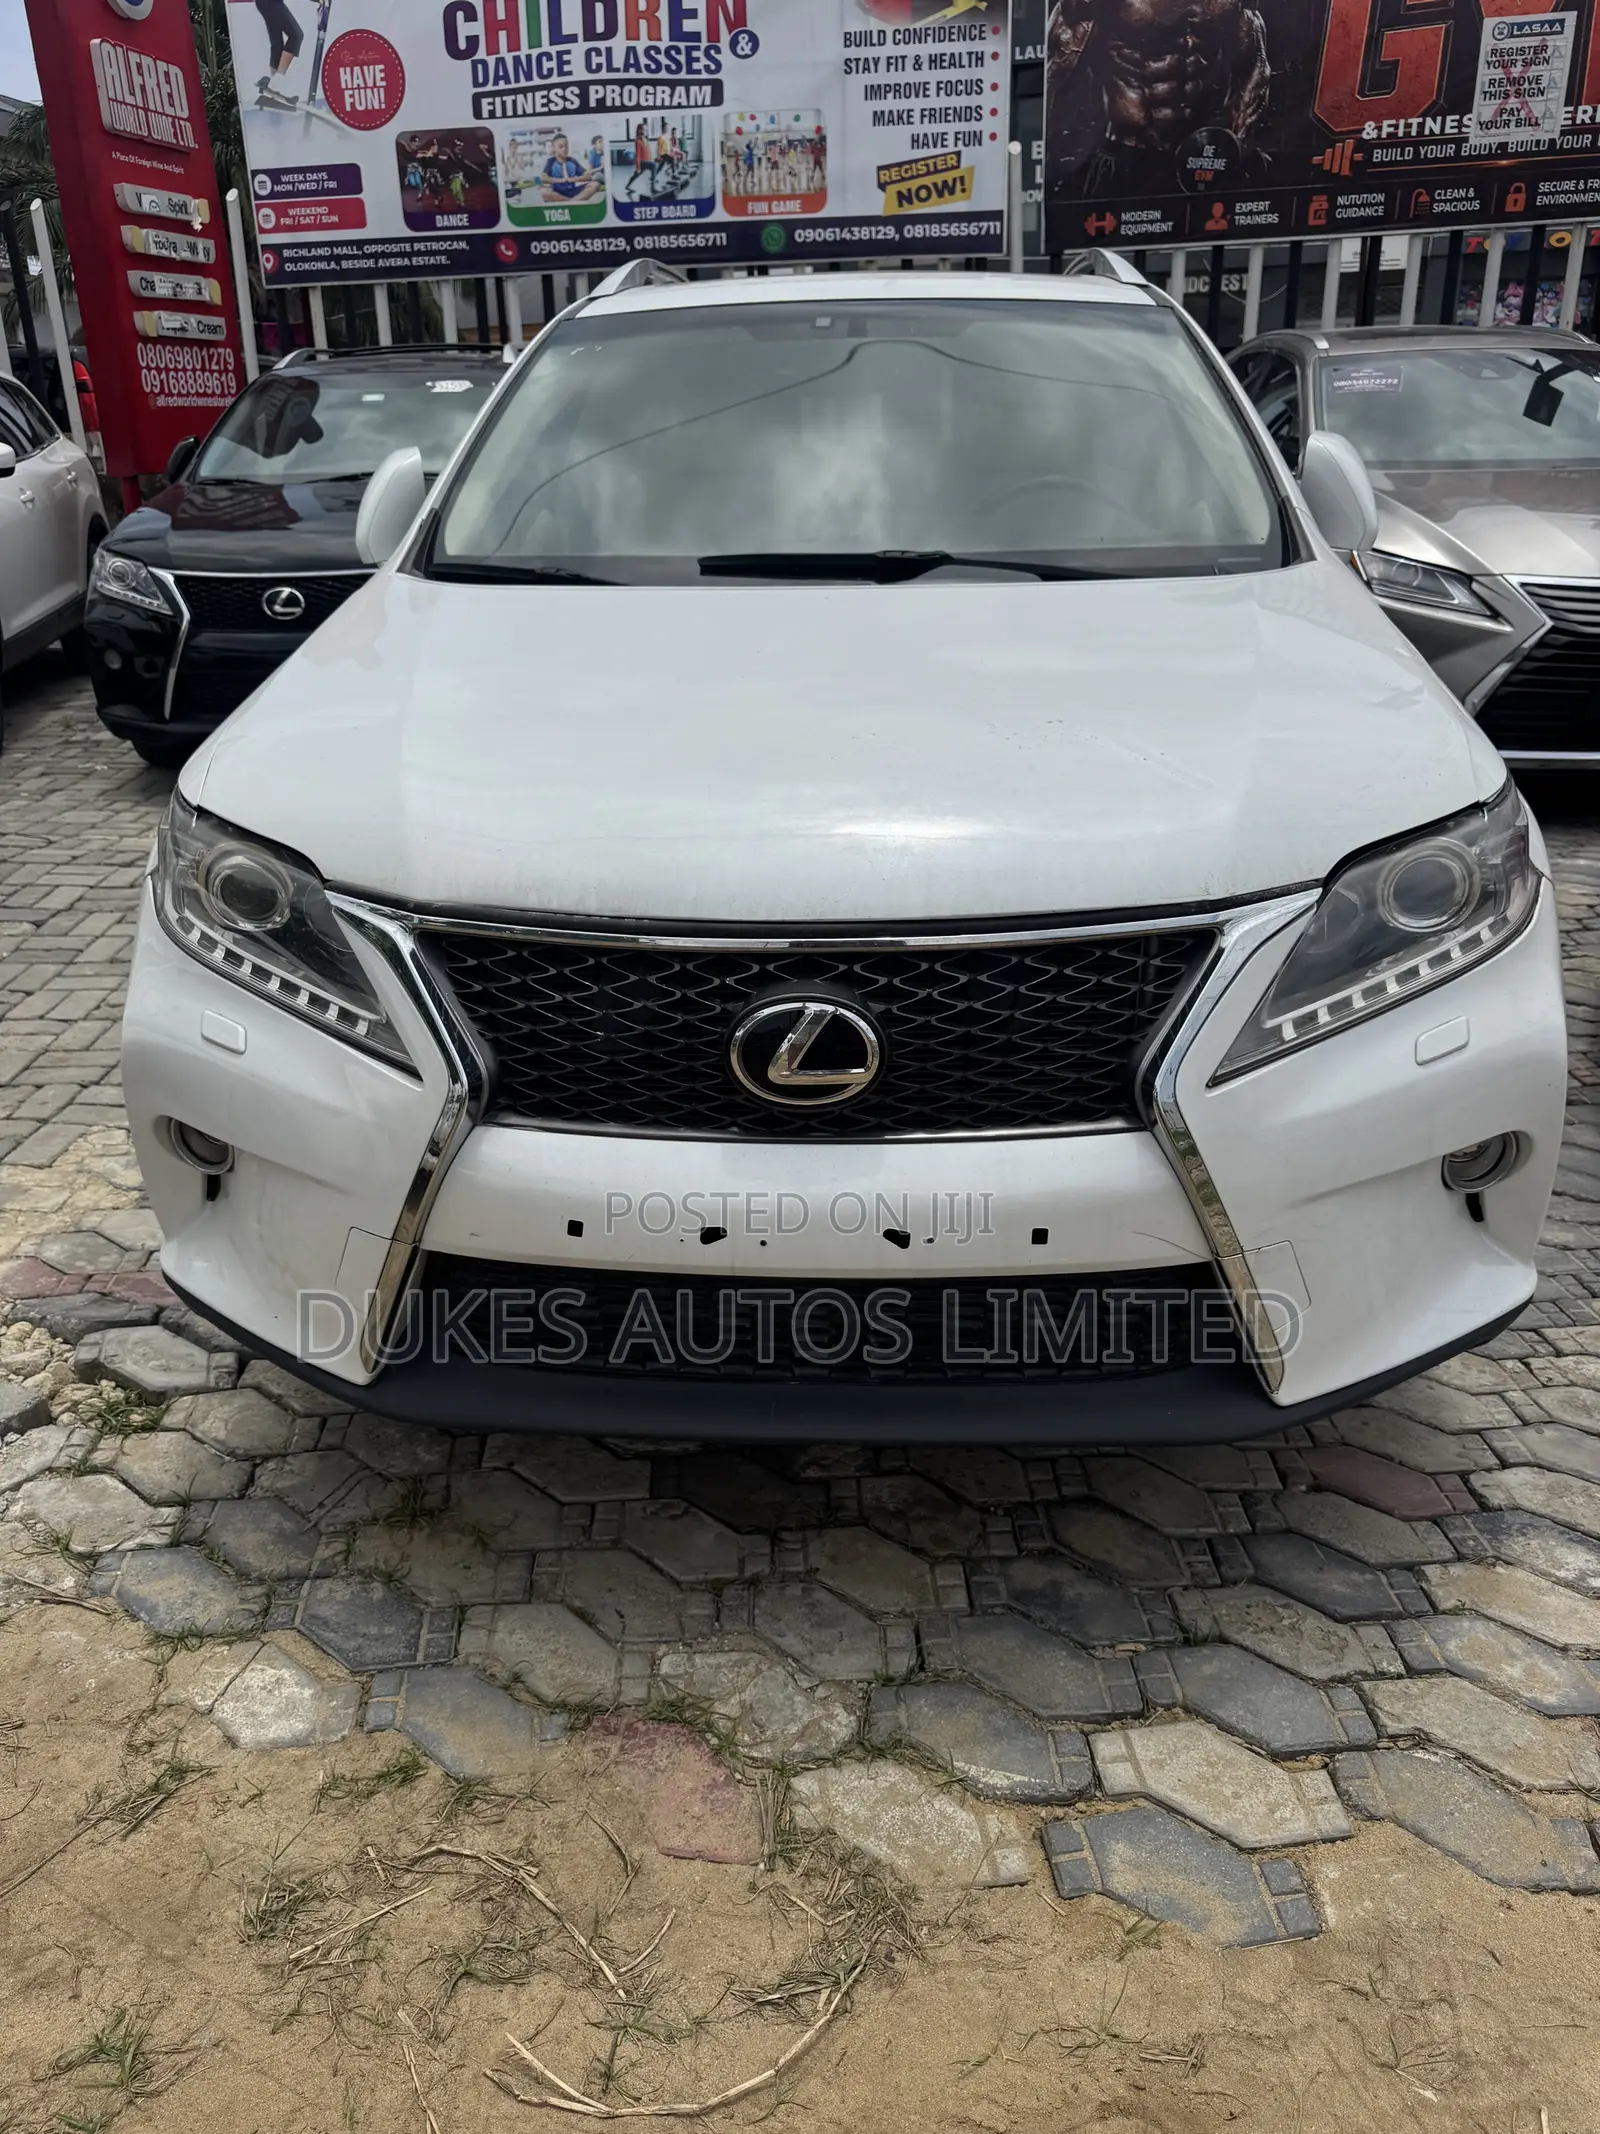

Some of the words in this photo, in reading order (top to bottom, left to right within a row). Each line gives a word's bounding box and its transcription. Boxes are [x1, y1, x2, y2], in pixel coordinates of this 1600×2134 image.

[442, 0, 748, 61] CHILDREN
[843, 29, 887, 49] BUILD
[892, 23, 988, 46] CONFIDENCE
[1512, 22, 1563, 36] LASAA
[736, 34, 754, 56] &
[1490, 44, 1549, 59] REGISTER
[471, 48, 573, 89] DANCE
[584, 43, 723, 75] CLASSES
[843, 56, 881, 75] STAY
[886, 54, 908, 73] FIT
[912, 54, 924, 72] &
[928, 50, 985, 71] HEALTH
[1485, 58, 1518, 70] YOUR
[1520, 55, 1551, 68] SIGN
[100, 41, 190, 119] ALFRED
[339, 64, 387, 89] HAVE
[1487, 74, 1544, 89] REMOVE
[864, 81, 931, 102] IMPROVE
[936, 78, 985, 98] FOCUS
[1482, 89, 1511, 102] THIS
[1513, 86, 1546, 99] SIGN
[343, 87, 387, 112] FUN!
[480, 85, 581, 119] FITNESS
[588, 84, 713, 109] PROGRAM
[872, 108, 915, 127] MAKE
[919, 105, 984, 125] FRIENDS
[1499, 106, 1523, 119] PAY
[109, 100, 149, 137] WORLD
[149, 111, 177, 144] WINE
[175, 118, 199, 149] LTD.
[1361, 114, 1475, 140] &FITNES
[1478, 118, 1511, 131] YOUR
[1514, 116, 1542, 128] BILL
[910, 131, 949, 150] HAVE
[953, 129, 983, 148] FUN
[1372, 146, 1414, 162] BUILD
[1418, 143, 1456, 159] YOUR
[1507, 138, 1549, 153] BUILD
[1555, 135, 1593, 150] YOUR
[280, 173, 304, 182] WEEK
[305, 172, 328, 182] DAYS
[878, 155, 957, 184] REGISTER
[273, 183, 294, 193] MON
[323, 180, 338, 190] FRI
[895, 175, 966, 208] NOW!
[1434, 188, 1467, 201] CLEAN
[1467, 186, 1476, 198] &
[1537, 179, 1577, 193] SECURE
[1577, 179, 1585, 190] &
[1431, 199, 1481, 214] SPACIOUS
[1535, 192, 1600, 206] ENVIRONMEN
[288, 207, 329, 216] WEEKEND
[543, 208, 572, 223] YOGA
[633, 205, 660, 220] STEP
[661, 204, 697, 219] BOARD
[747, 202, 770, 216] FUN
[771, 200, 803, 214] GAME
[1235, 201, 1271, 214] EXPERT
[1335, 205, 1386, 219] GUIDANCE
[280, 217, 294, 226] FRI
[299, 216, 315, 225] SAT
[321, 214, 339, 224] SUN
[435, 213, 470, 228] DANCE
[1120, 210, 1162, 223] MODERN
[1233, 213, 1280, 227] TRAINERS
[795, 225, 900, 243] 09061438129,
[903, 220, 1002, 238] 08185656711
[1120, 221, 1175, 236] EQUIPMENT
[282, 247, 332, 258] RICHLAND
[333, 245, 363, 256] MALL,
[363, 243, 412, 254] OPPOSITE
[413, 240, 470, 252] PETROCAN,
[530, 237, 631, 255] 09061438129,
[633, 232, 728, 250] 08185656711
[284, 260, 340, 272] OLOKONLA,
[341, 258, 376, 269] BESIDE
[376, 257, 410, 268] AVERA
[412, 256, 450, 267] ESTATE.
[197, 320, 225, 336] Cream
[137, 342, 235, 371] 08069801279
[141, 368, 237, 395] 09168889619
